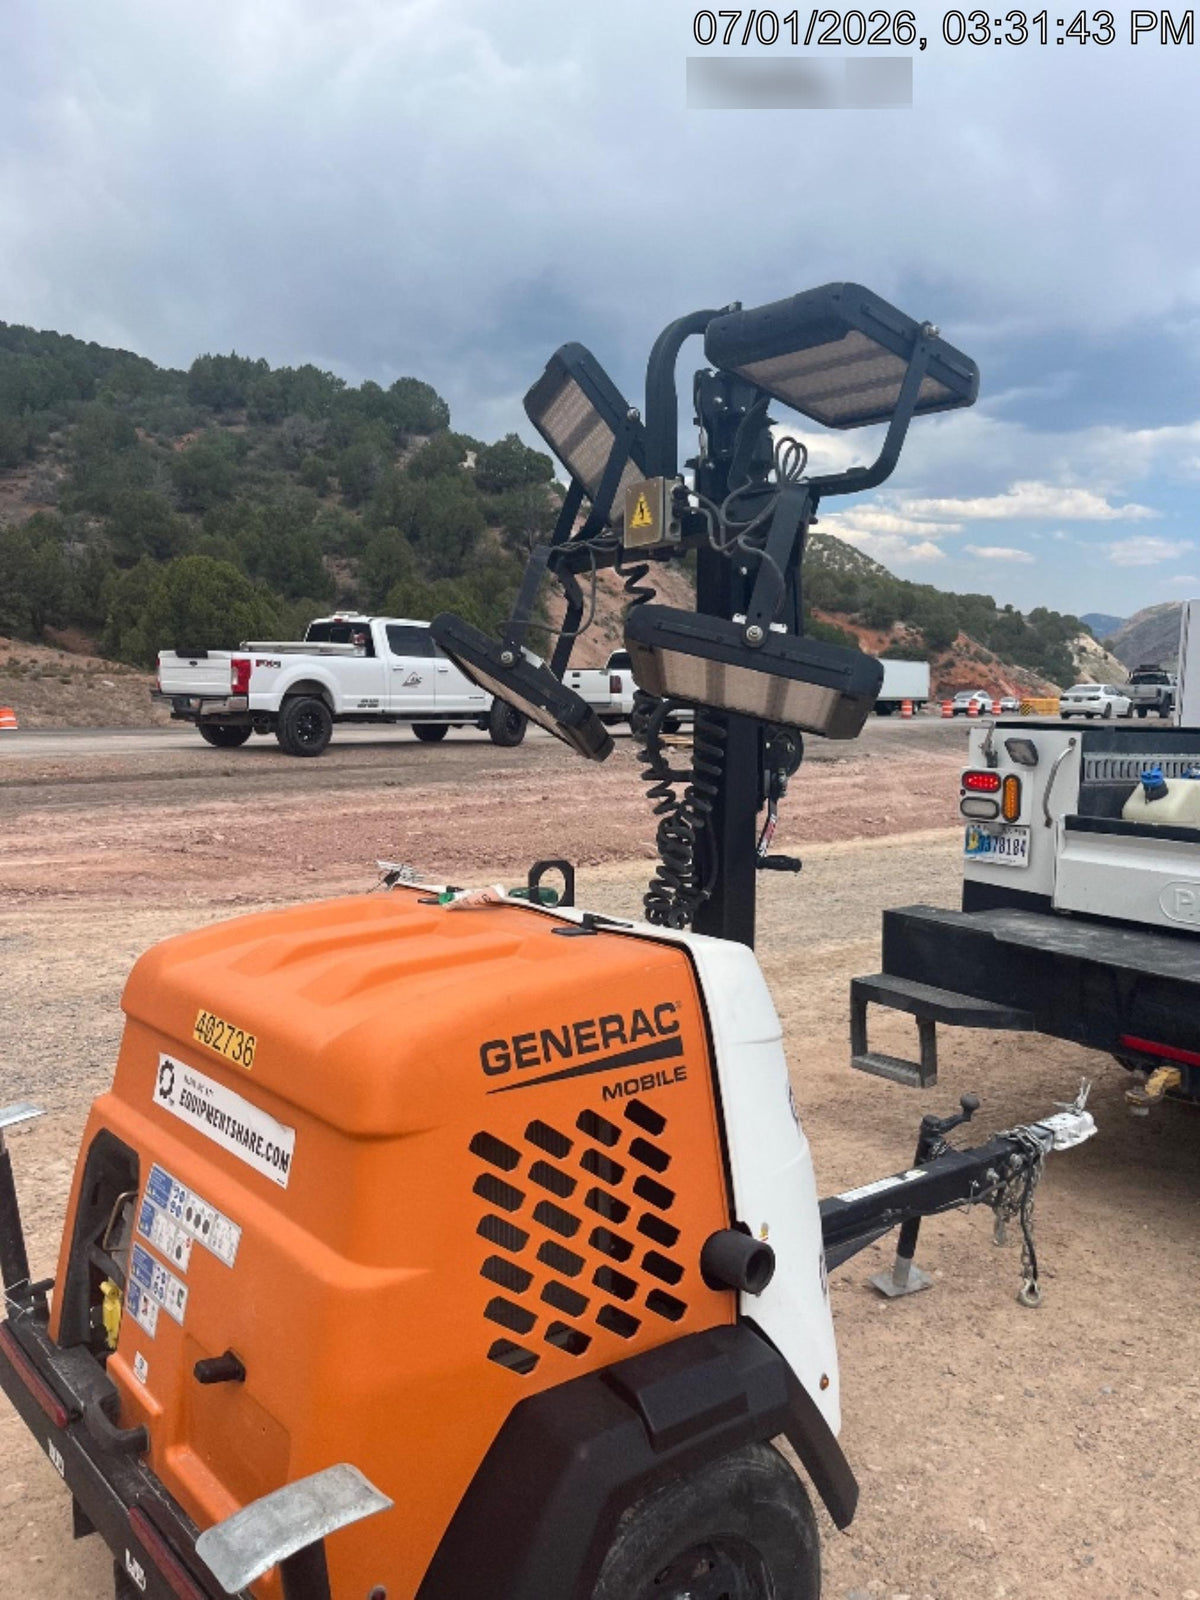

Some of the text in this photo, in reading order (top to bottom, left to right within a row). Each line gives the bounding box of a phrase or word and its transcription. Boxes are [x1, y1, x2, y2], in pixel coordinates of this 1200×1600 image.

[195, 1012, 255, 1067] 402736
[479, 1002, 681, 1076] GENERAC
[601, 1065, 688, 1101] MOBILE
[178, 1088, 291, 1174] EQUIPMENTSHARE.COM
